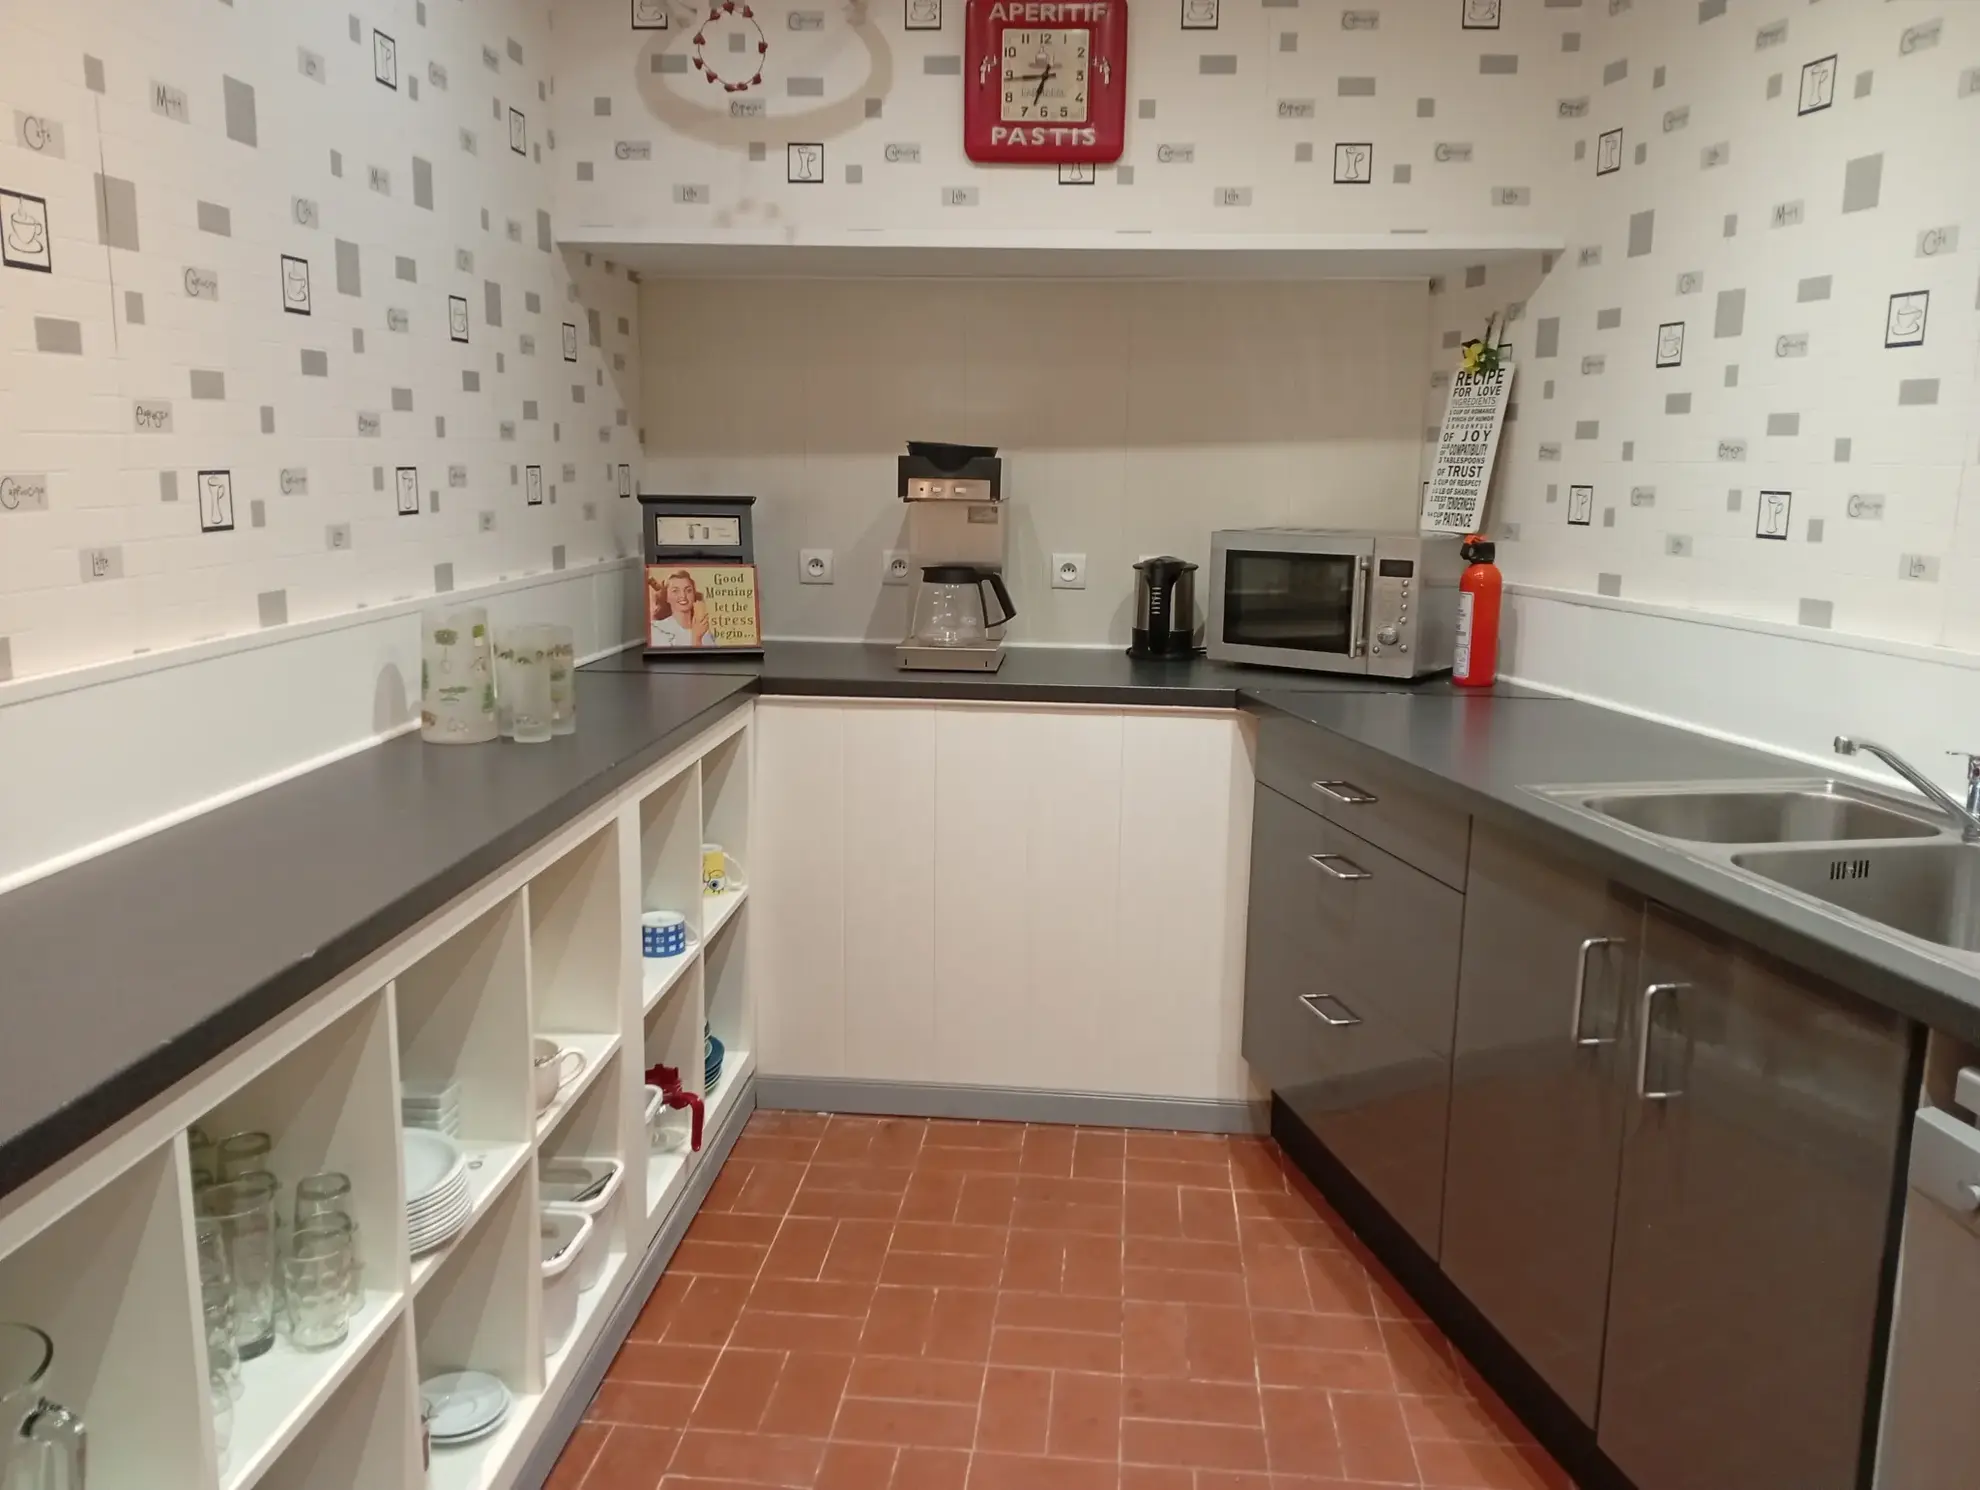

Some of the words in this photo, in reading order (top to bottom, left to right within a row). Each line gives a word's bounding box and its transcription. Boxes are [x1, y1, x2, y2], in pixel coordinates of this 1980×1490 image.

[989, 2, 1108, 22] APERITIF
[1021, 33, 1030, 44] 11
[1040, 33, 1053, 44] 12
[1004, 46, 1017, 58] 10
[1077, 46, 1085, 58] 2
[1005, 69, 1014, 80] 9
[1076, 70, 1084, 81] 3
[1005, 92, 1013, 103] 8
[1075, 92, 1084, 102] 4
[1021, 106, 1029, 117] 7
[1040, 106, 1048, 117] 6
[1060, 106, 1068, 117] 5
[991, 126, 1097, 146] PASTIS
[1455, 368, 1506, 387] RECIPE
[1453, 387, 1472, 397] FOR
[1477, 385, 1502, 397] LOVE
[1443, 432, 1454, 442] OF
[1461, 430, 1492, 442] JOY
[1443, 456, 1486, 464] TABLESPOONS
[1437, 468, 1446, 476] OF
[1448, 465, 1483, 478] TRUST
[1457, 479, 1482, 487] RESPECT
[1453, 488, 1478, 496] SHARING
[1443, 512, 1473, 528] PATIENCE
[713, 573, 744, 585] Good
[705, 586, 753, 599] Morning
[715, 601, 729, 612] let
[732, 601, 749, 612] the
[711, 615, 754, 627] stress
[713, 627, 755, 640] begin...
